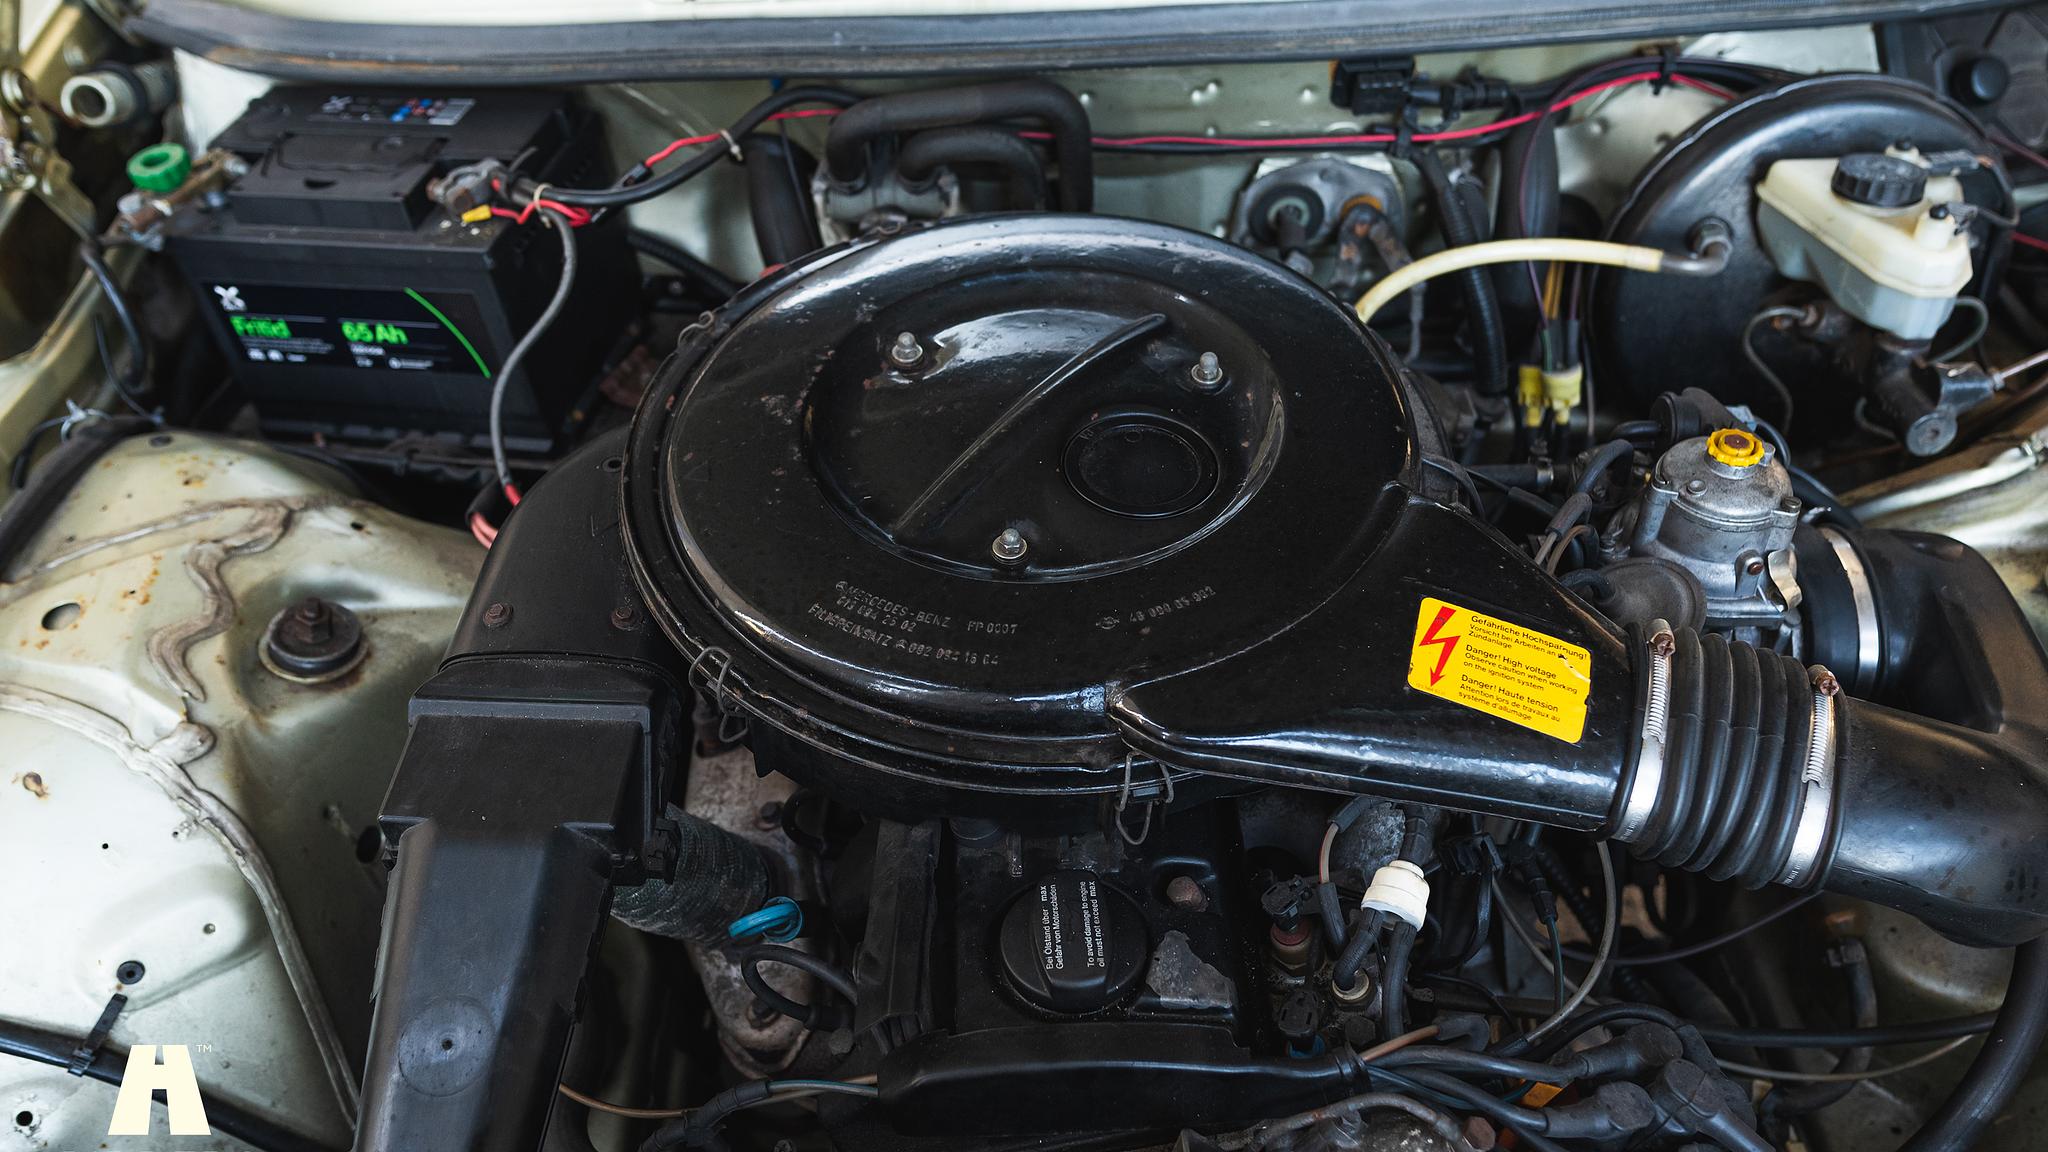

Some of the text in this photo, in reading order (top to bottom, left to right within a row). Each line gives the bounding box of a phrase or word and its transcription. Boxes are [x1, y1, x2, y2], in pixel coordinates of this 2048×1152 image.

[374, 323, 409, 344] Ah
[1514, 638, 1546, 654] Arbeiten
[1466, 644, 1557, 680] Danger! High voltage
[1465, 652, 1578, 695] Observe caution when working
[1475, 664, 1486, 673] the
[1488, 668, 1516, 684] ignition
[1517, 678, 1544, 692] system
[1460, 683, 1494, 699] Attention
[1496, 694, 1510, 704] lors
[1511, 699, 1520, 708] de
[1522, 704, 1549, 718] travaux
[1462, 674, 1497, 692] Danger!
[1498, 686, 1524, 702] Haute
[1527, 696, 1559, 712] tension
[1079, 881, 1088, 902] engine
[1090, 899, 1100, 924] exceed
[1082, 910, 1091, 936] damage
[1093, 925, 1102, 937] not
[1084, 937, 1094, 956] avoid
[1095, 938, 1104, 956] must
[1045, 956, 1054, 970] Bei
[1054, 945, 1064, 970] Gefahr
[1087, 957, 1095, 968] To
[1097, 957, 1105, 968] oil
